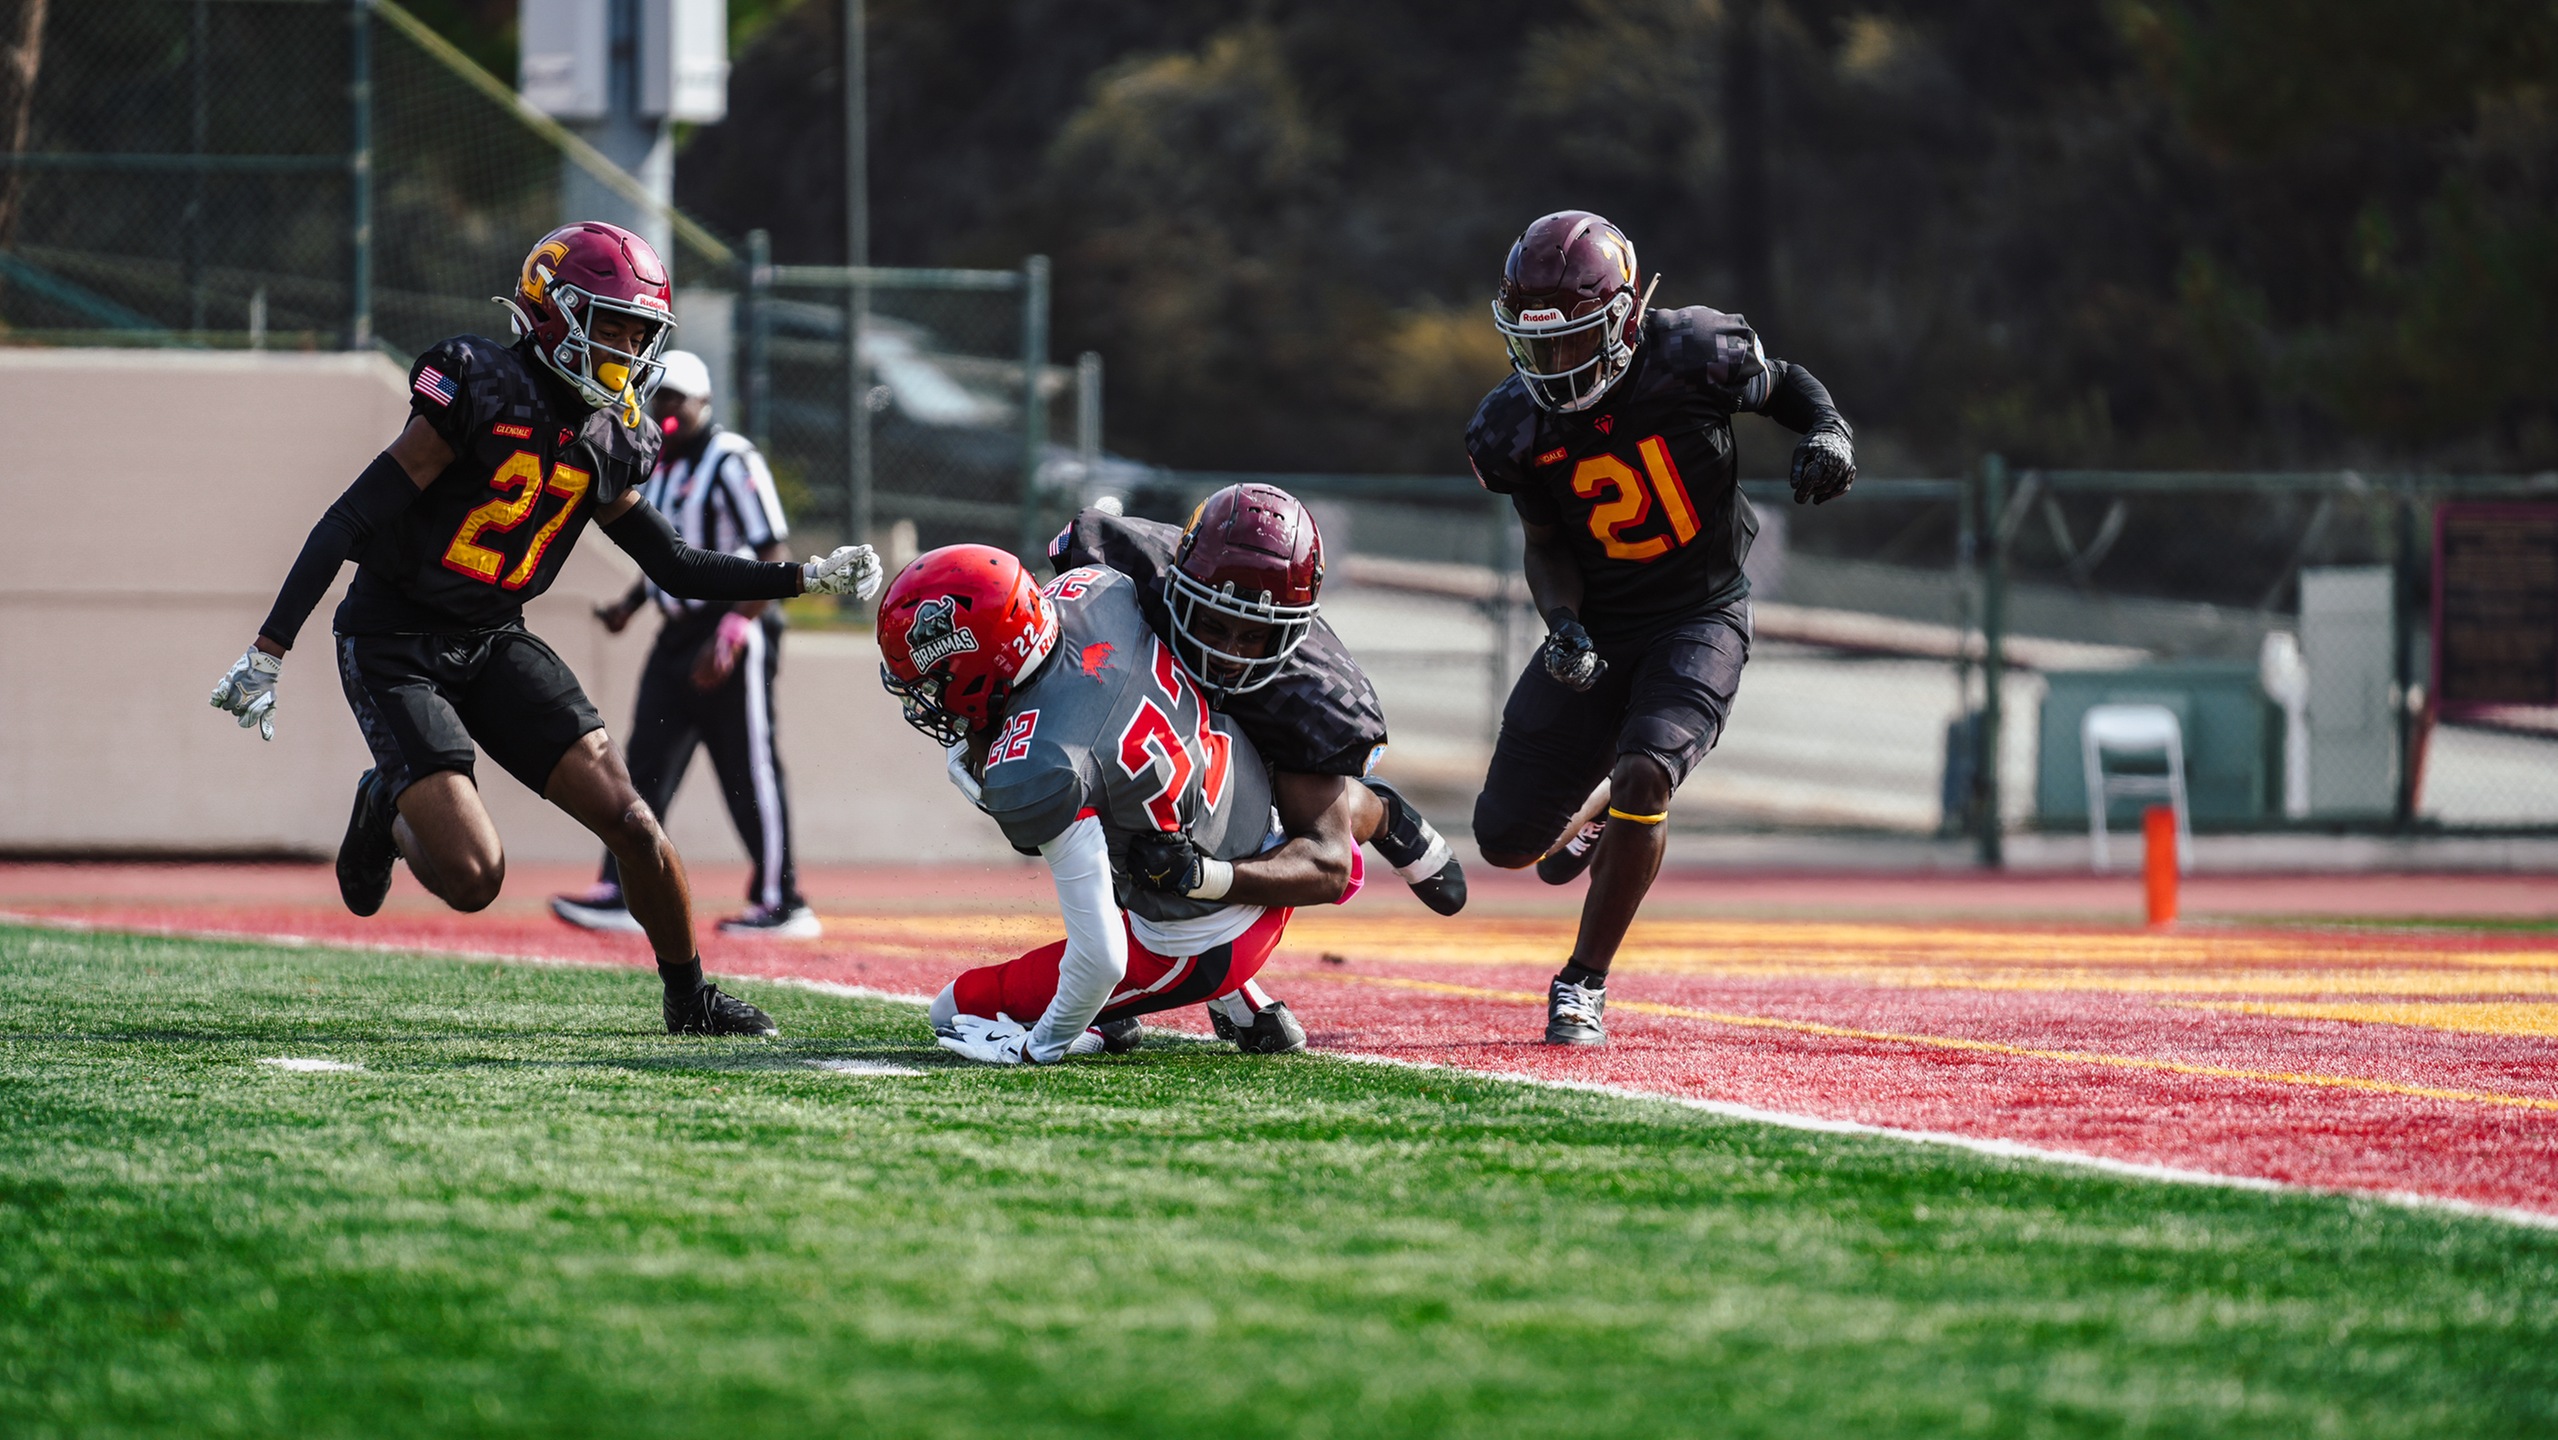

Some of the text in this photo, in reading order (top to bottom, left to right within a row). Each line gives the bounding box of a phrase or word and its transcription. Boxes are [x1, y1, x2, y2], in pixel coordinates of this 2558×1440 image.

[521, 240, 570, 304] G
[640, 297, 666, 311] Riddell
[1523, 312, 1557, 322] Riddell
[496, 425, 530, 437] GLENDALE
[441, 449, 591, 591] 27
[1570, 434, 1702, 563] 21
[912, 630, 976, 673] BRAHMAS
[1013, 622, 1040, 657] 22
[985, 709, 1040, 770] 22
